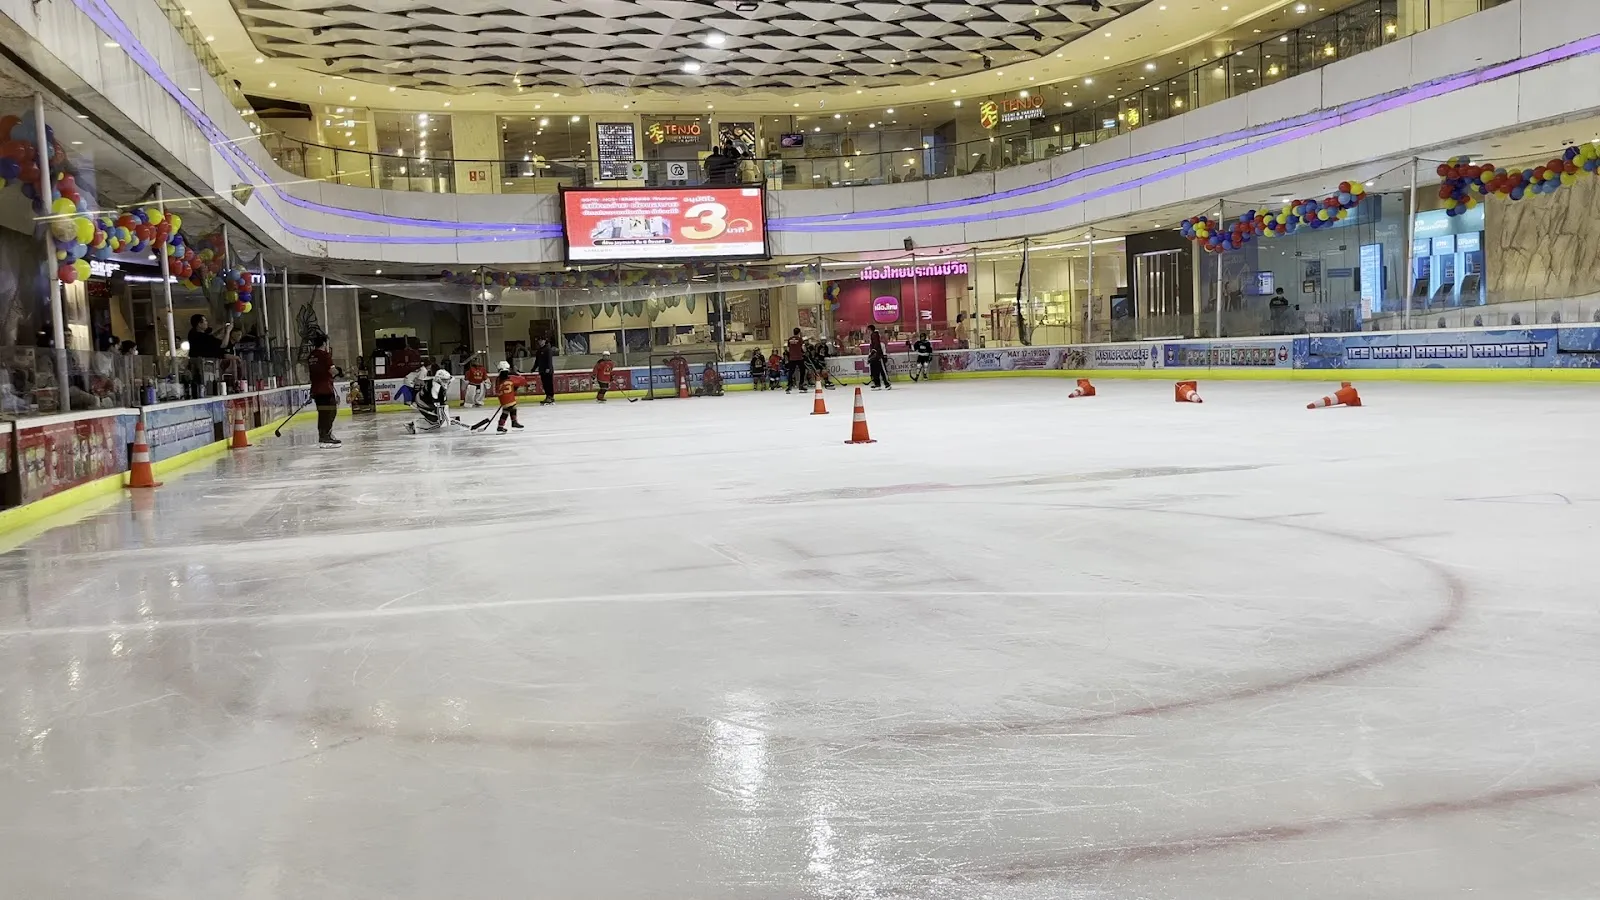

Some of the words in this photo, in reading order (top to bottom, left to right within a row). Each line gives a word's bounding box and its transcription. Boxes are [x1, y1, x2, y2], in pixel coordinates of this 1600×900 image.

[1001, 95, 1044, 112] TENJO
[664, 124, 701, 135] TENJO
[680, 202, 728, 240] 3
[860, 261, 968, 280] เมืองไทยประกันชีวิต
[1007, 350, 1020, 358] MAY
[1132, 349, 1149, 360] CAFE
[1347, 347, 1370, 360] ICE
[1371, 346, 1412, 359] NAKA
[1414, 344, 1467, 359] ARENA
[1472, 342, 1548, 358] RANGSIT
